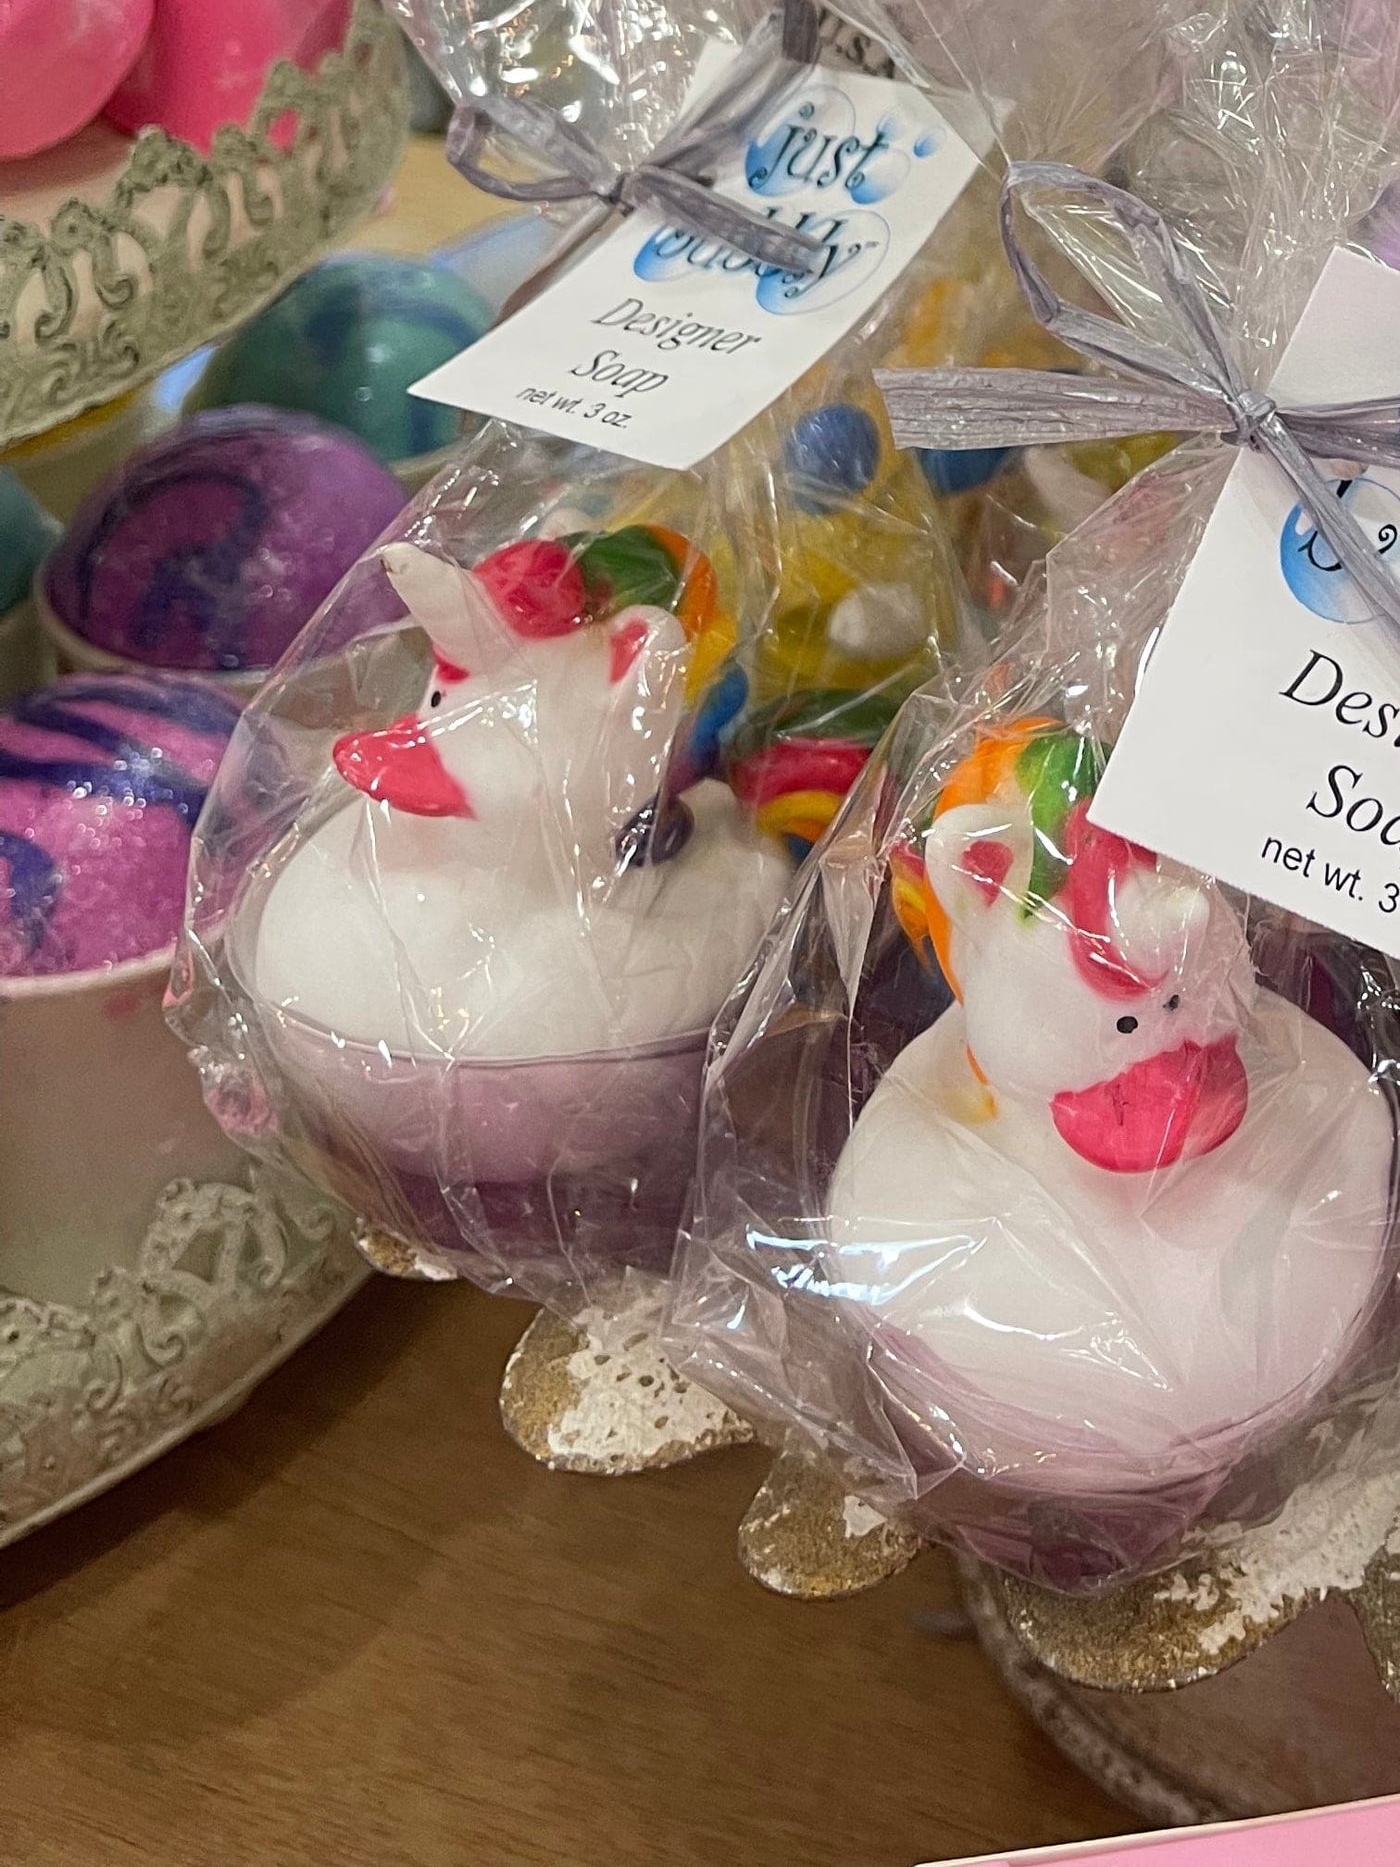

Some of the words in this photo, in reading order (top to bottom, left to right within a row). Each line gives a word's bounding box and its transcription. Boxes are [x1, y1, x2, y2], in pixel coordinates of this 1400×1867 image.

[590, 297, 762, 355] Designer
[568, 349, 669, 398] Soap
[516, 385, 557, 407] net
[555, 396, 584, 415] wt.
[583, 402, 606, 420] 3
[601, 410, 632, 429] oz.
[1261, 836, 1315, 878] net
[1324, 862, 1364, 901] wt.
[1378, 883, 1400, 913] 3
